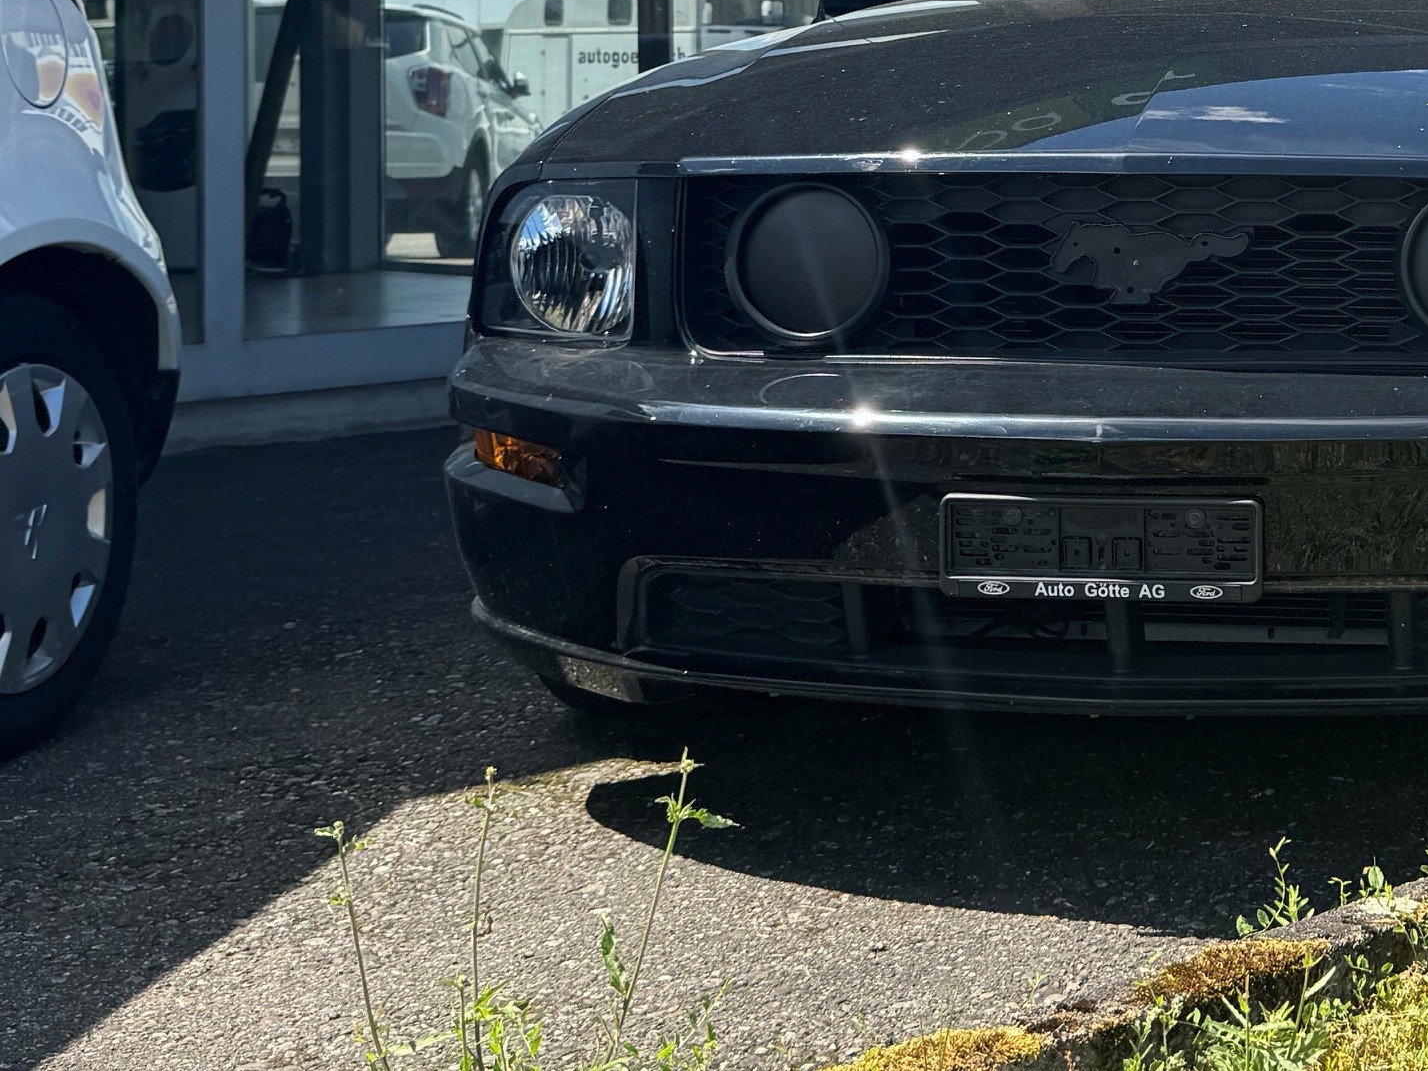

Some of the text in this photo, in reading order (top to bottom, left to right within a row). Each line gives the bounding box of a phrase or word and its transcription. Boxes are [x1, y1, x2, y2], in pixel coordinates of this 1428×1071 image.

[1034, 582, 1166, 599] Auto Götte AG
